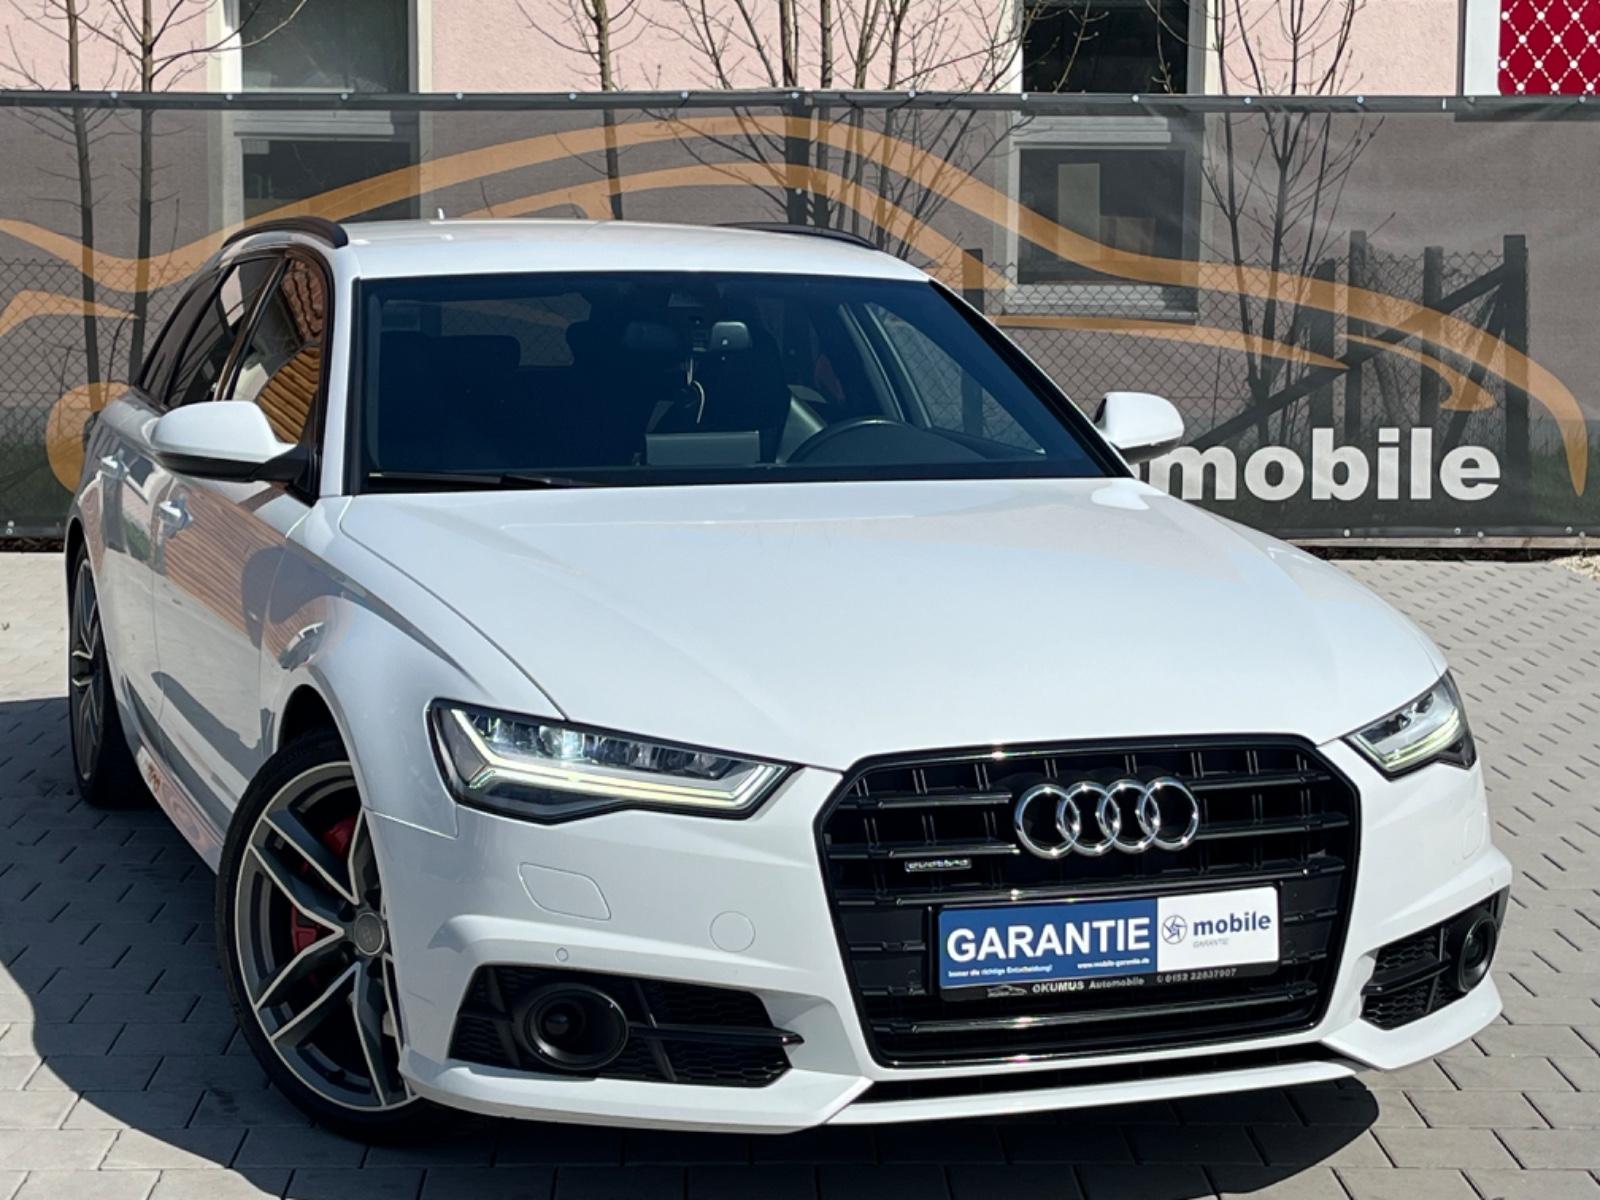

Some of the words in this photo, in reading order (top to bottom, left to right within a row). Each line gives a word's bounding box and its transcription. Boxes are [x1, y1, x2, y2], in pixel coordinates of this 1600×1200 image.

[1129, 427, 1501, 501] mobile
[946, 917, 1151, 963] GARANTIE
[1193, 911, 1272, 936] mobile
[1032, 980, 1084, 994] OKUMUS
[1088, 976, 1145, 990] Automobile
